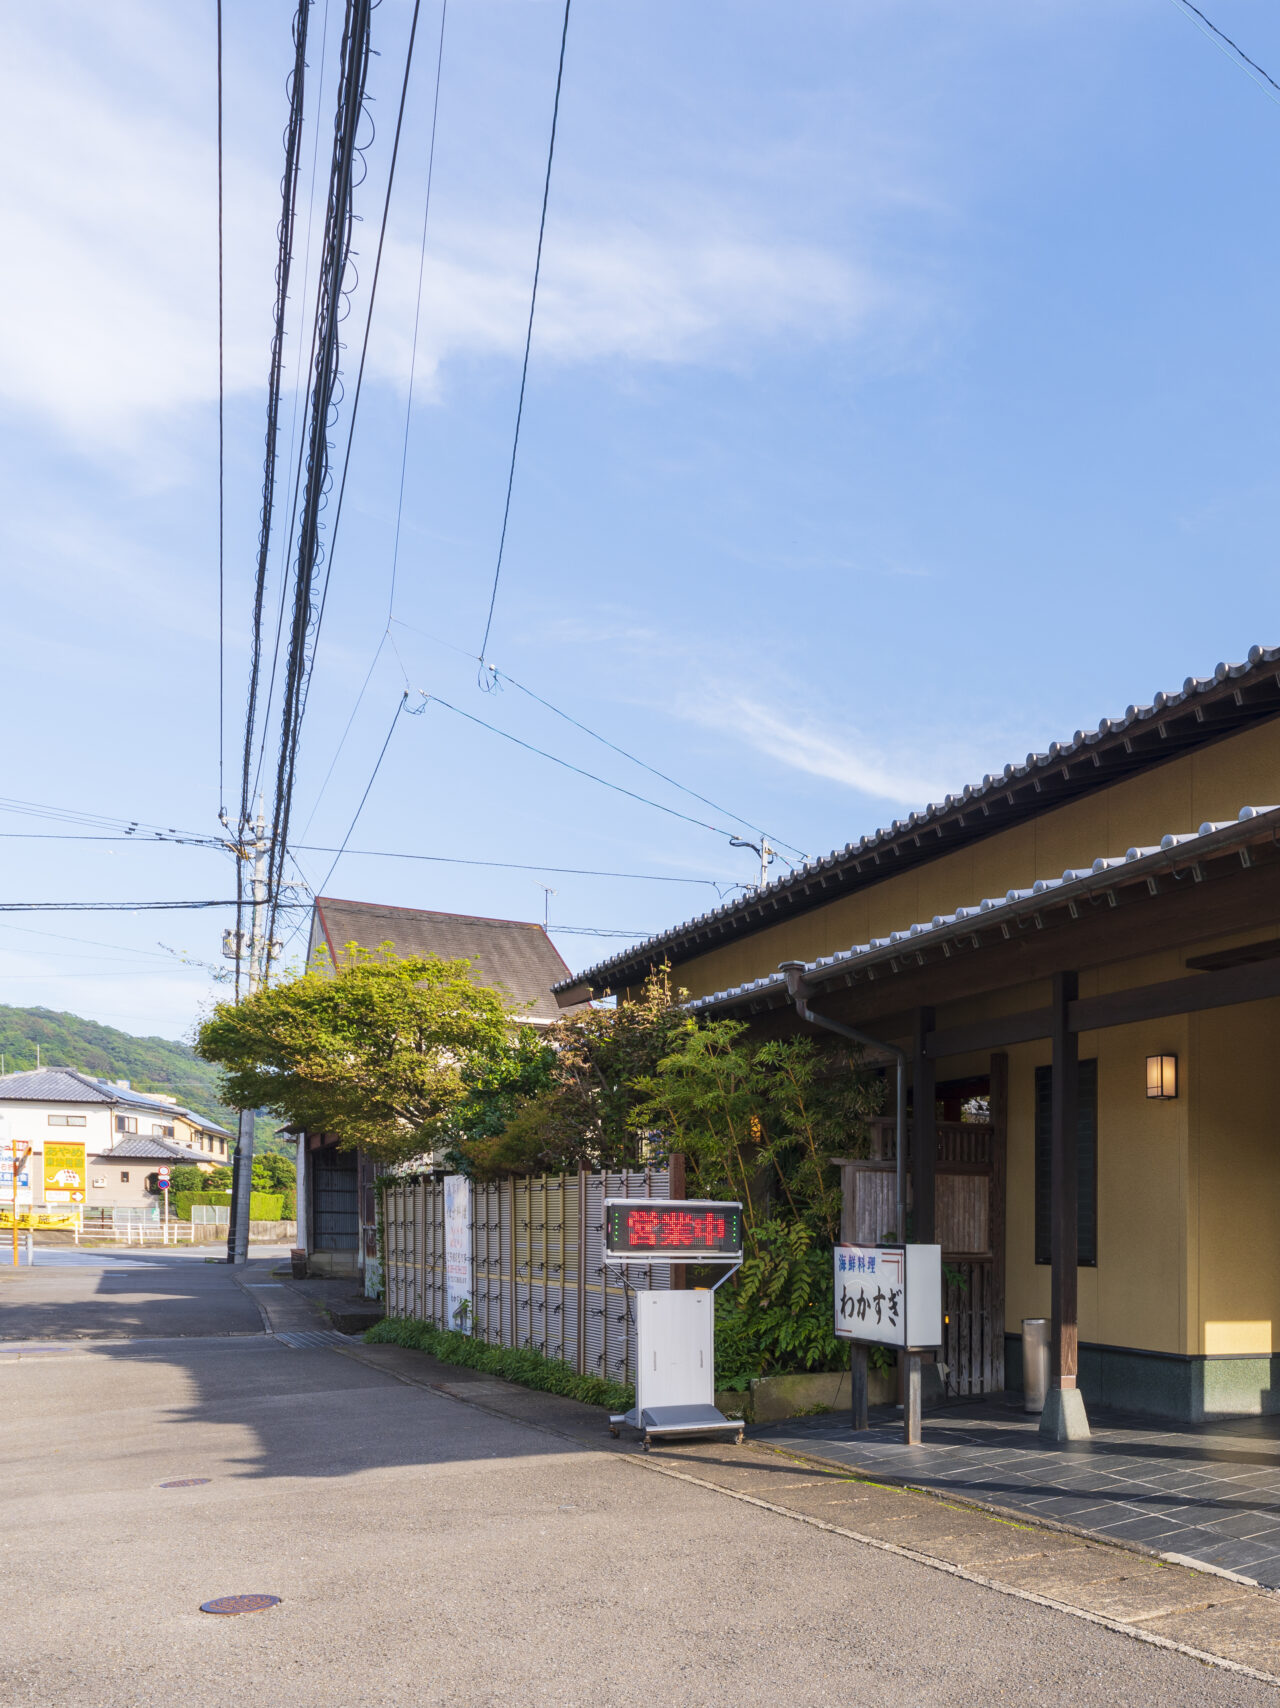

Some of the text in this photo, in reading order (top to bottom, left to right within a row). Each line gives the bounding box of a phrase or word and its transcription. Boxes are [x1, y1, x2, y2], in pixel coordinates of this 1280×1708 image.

[45, 1147, 83, 1157] あやめ
[627, 1211, 726, 1246] 営業中
[838, 1253, 876, 1274] 海鮮料理
[840, 1284, 902, 1327] わかすぎ
